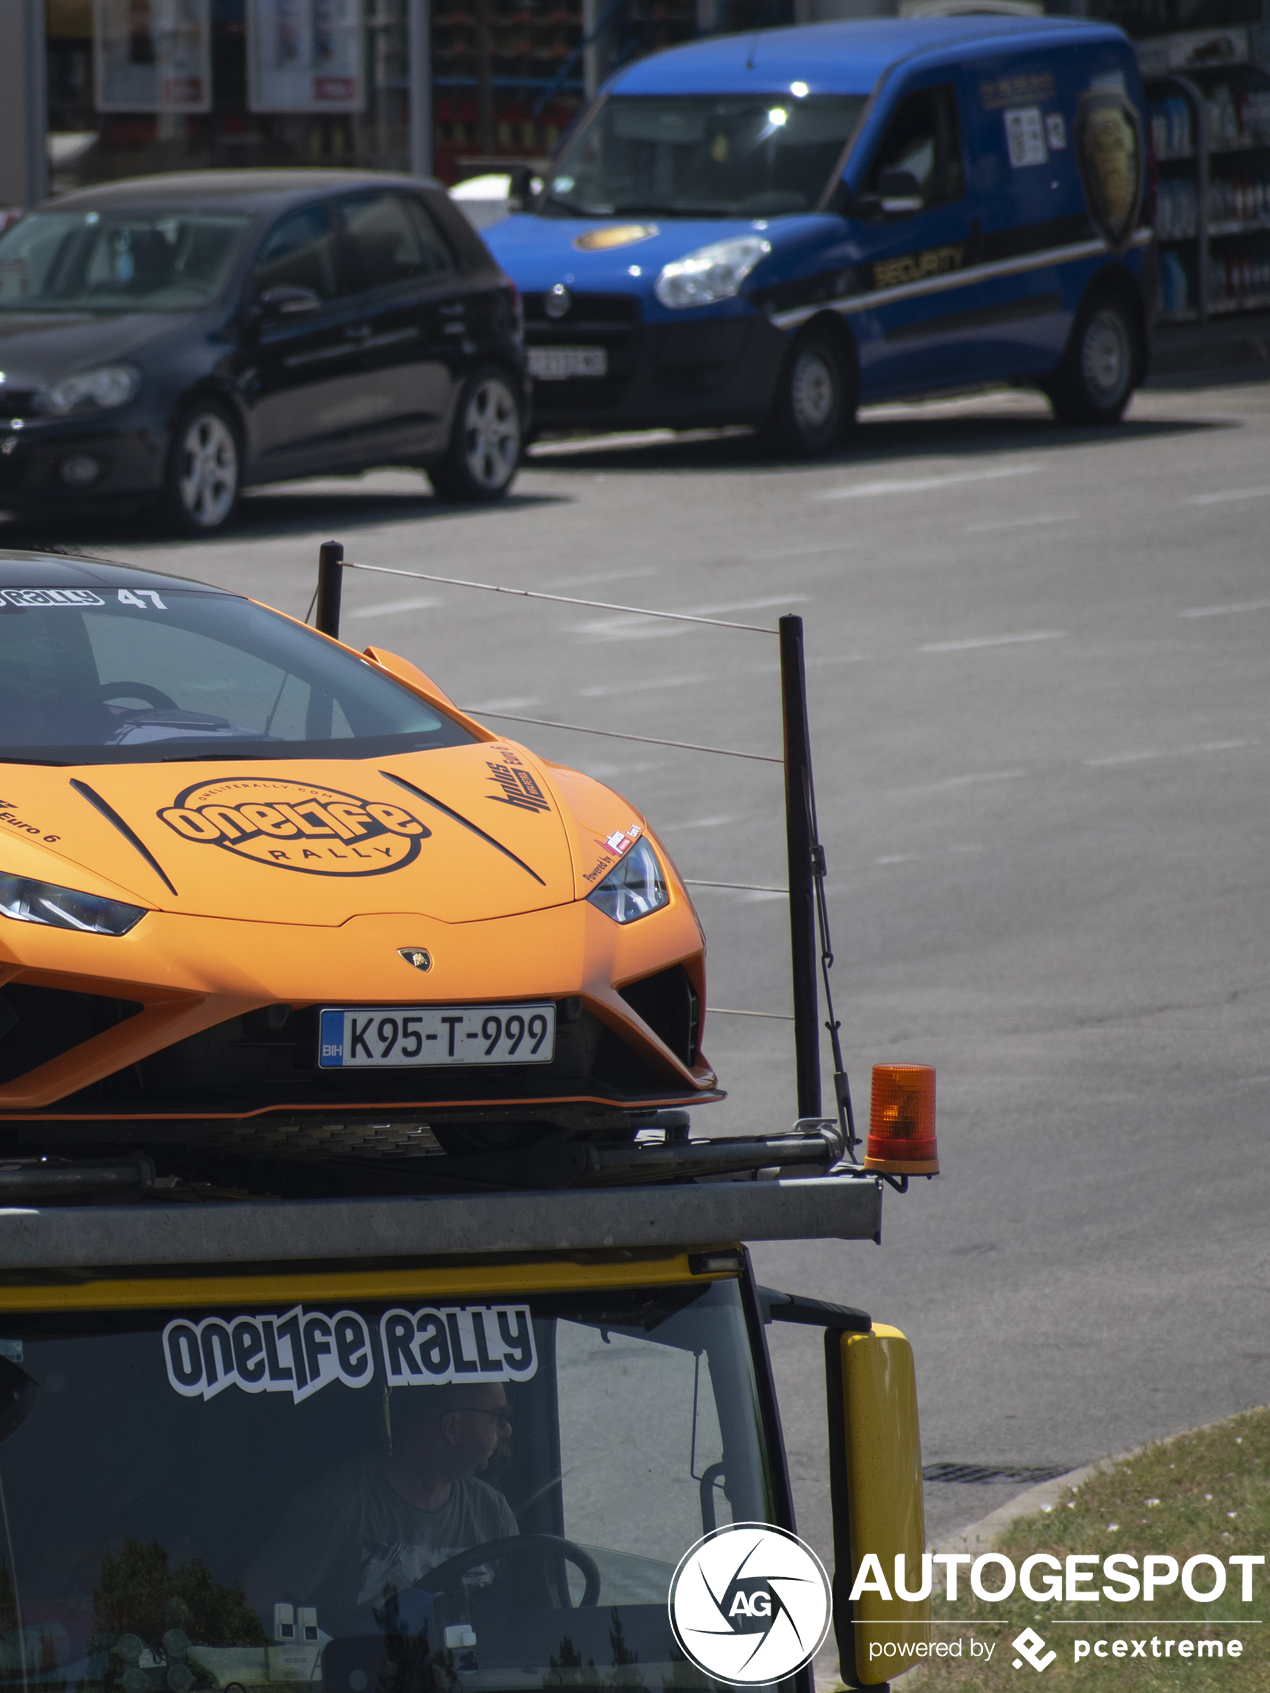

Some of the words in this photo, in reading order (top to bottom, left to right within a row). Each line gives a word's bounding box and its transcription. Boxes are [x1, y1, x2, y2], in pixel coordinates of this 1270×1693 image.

[873, 246, 964, 288] SECURITY
[117, 589, 168, 609] 47
[198, 783, 332, 801] ONELIFERALLY.COM
[43, 835, 61, 843] 6
[267, 847, 393, 860] RALLY
[322, 1045, 342, 1056] BIH
[350, 1014, 548, 1058] K95-T-999
